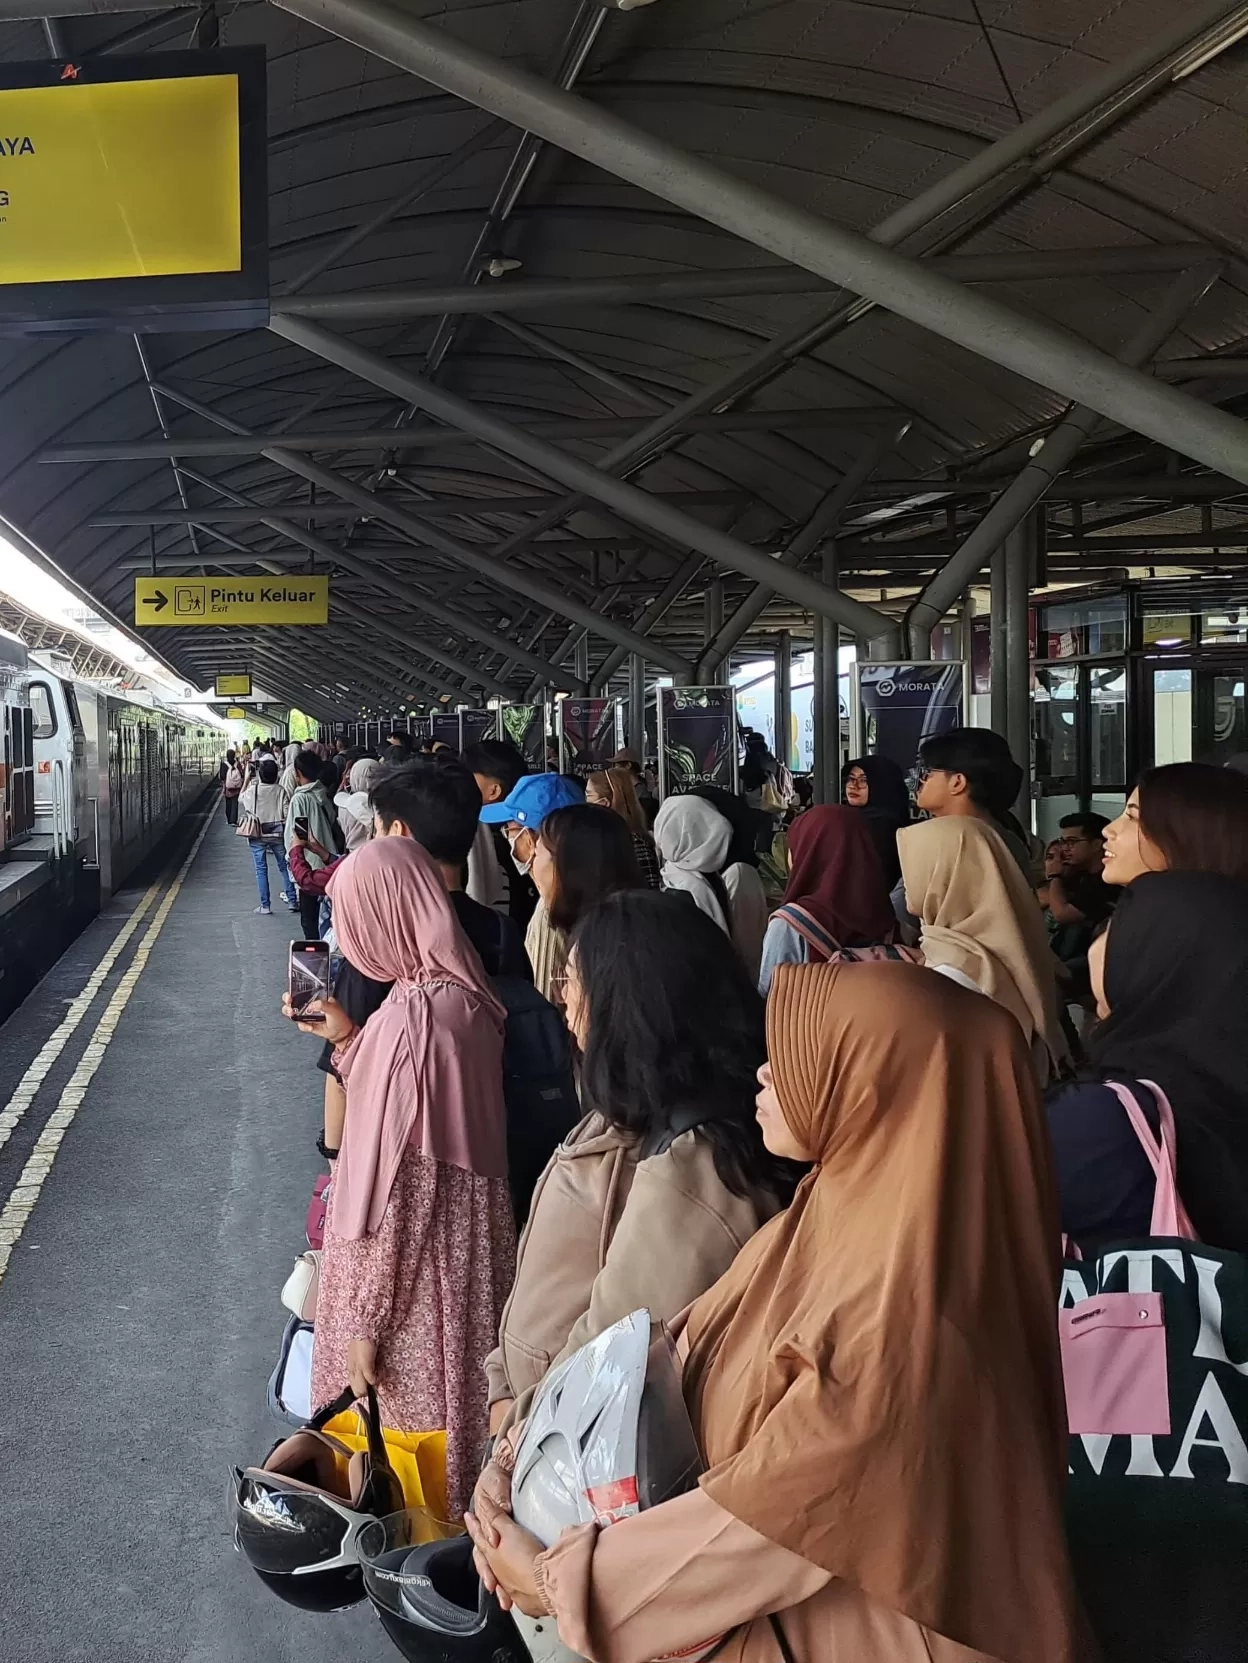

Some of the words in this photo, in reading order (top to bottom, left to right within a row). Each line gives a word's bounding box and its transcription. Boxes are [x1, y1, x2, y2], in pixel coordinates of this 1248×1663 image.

[211, 588, 255, 602] Pintu
[260, 588, 316, 602] Keluar
[211, 604, 228, 613] Exit
[898, 682, 945, 692] MORATA
[682, 773, 717, 782] SPACE
